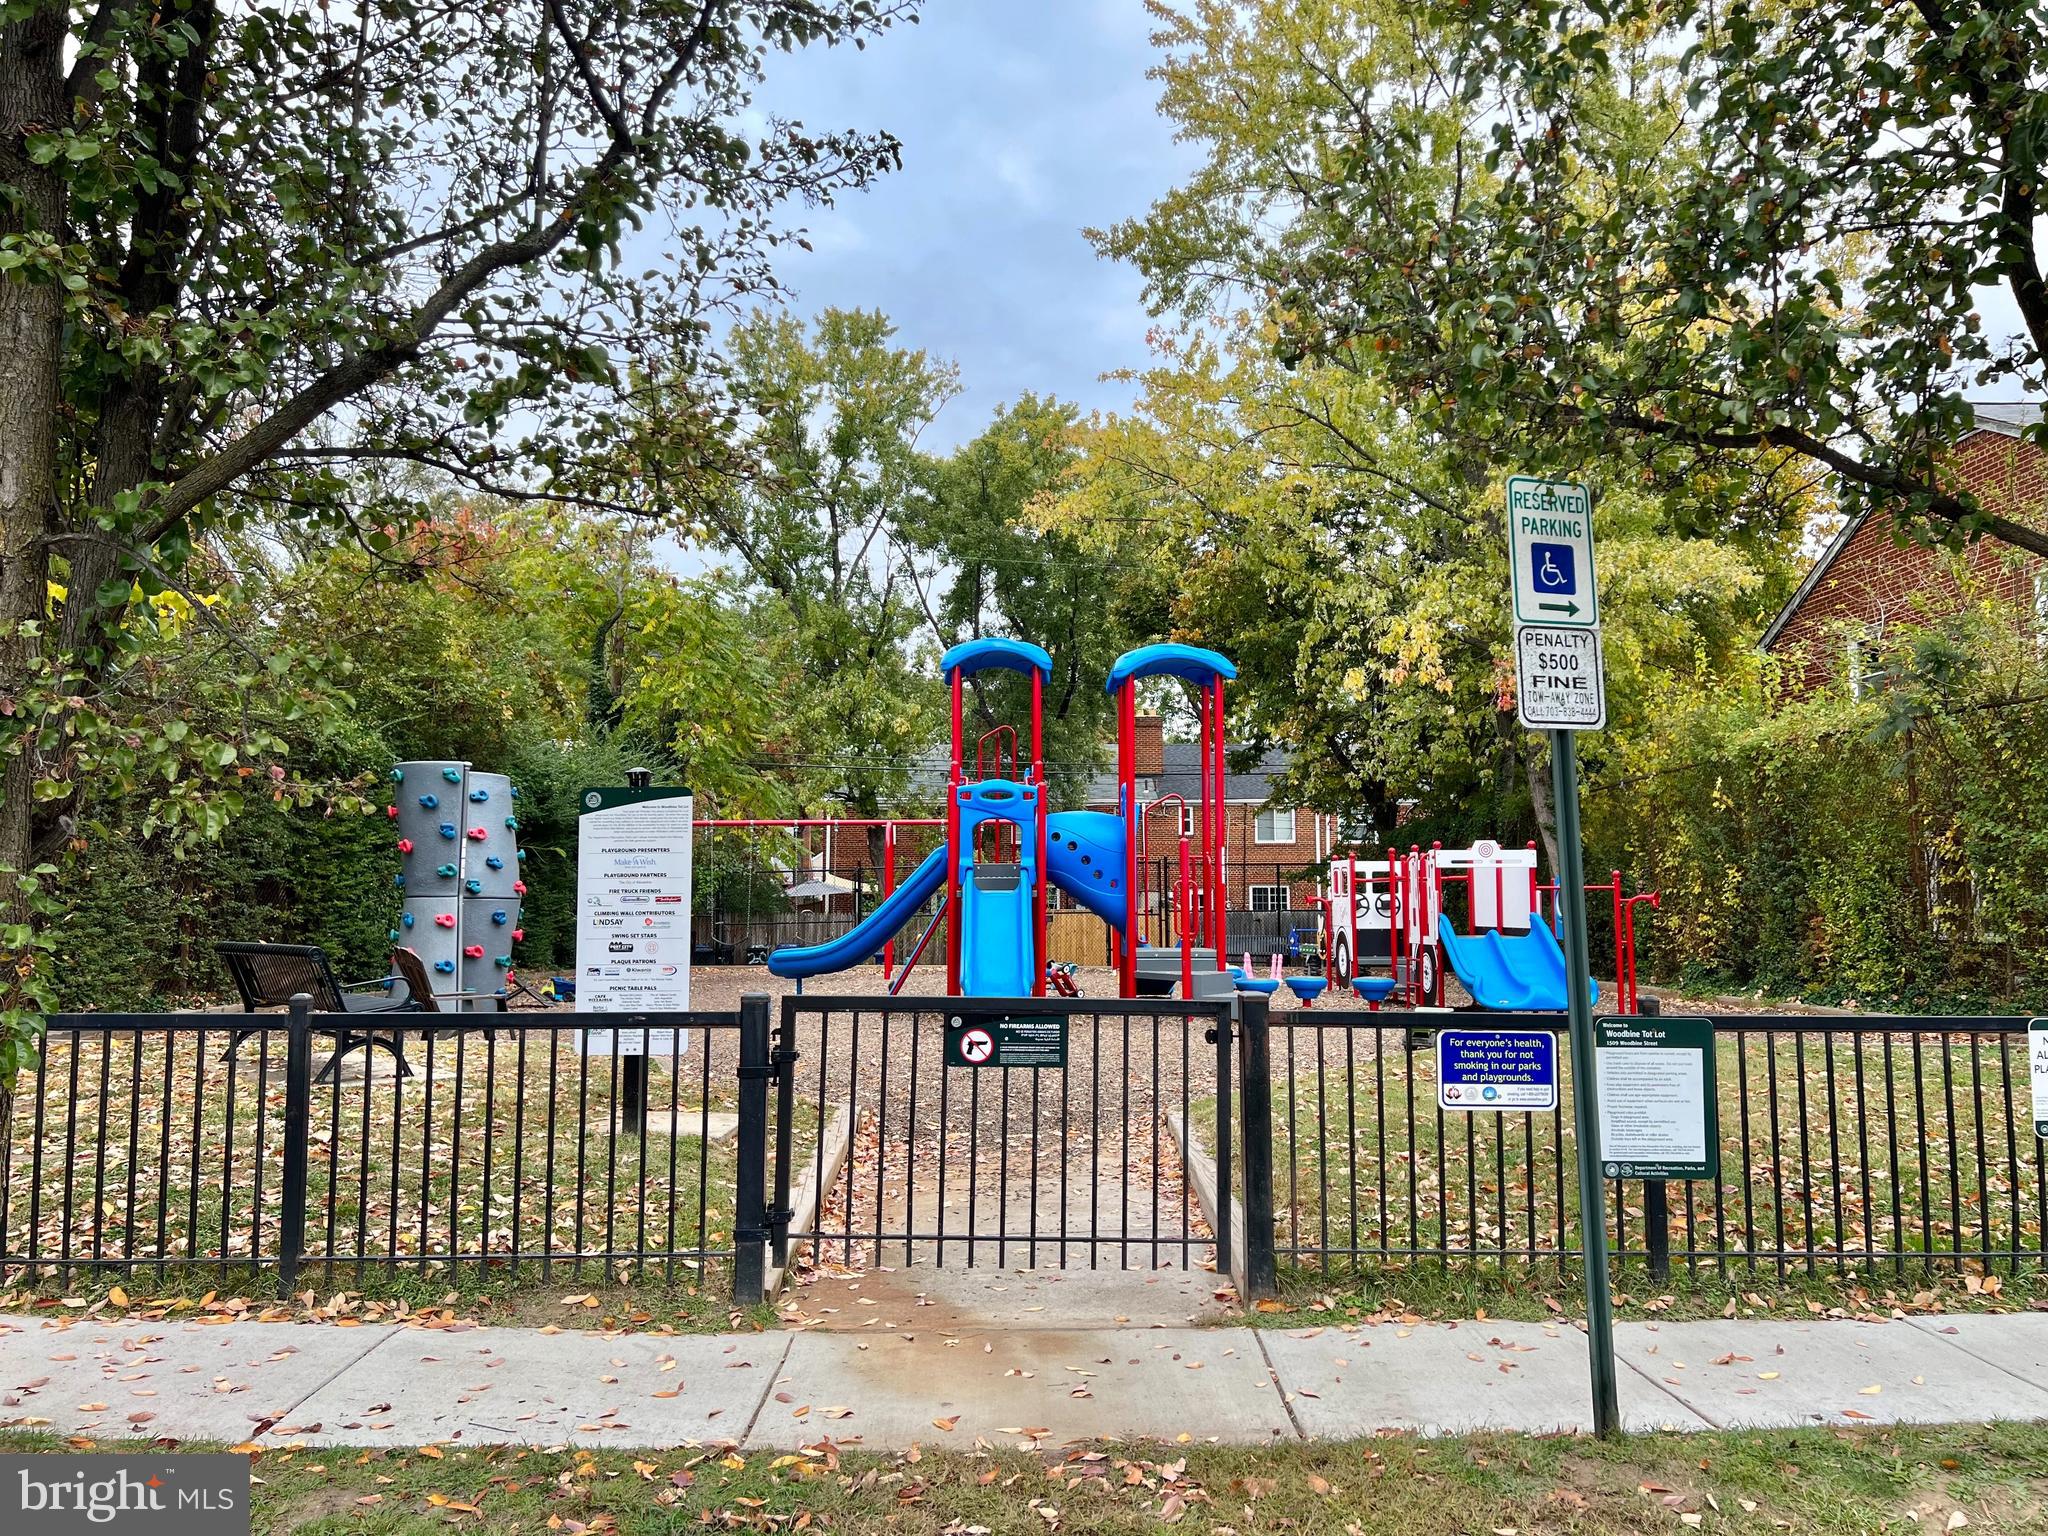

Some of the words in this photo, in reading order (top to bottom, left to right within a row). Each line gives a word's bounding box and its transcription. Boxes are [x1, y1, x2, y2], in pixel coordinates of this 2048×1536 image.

[1515, 491, 1584, 514] RESERVED
[1522, 517, 1581, 538] PARKING
[1526, 633, 1588, 648] PENALTY
[1539, 653, 1578, 670] $500
[1533, 675, 1587, 689] FINE
[1528, 691, 1569, 704] TOW-AWAY
[1575, 693, 1594, 704] ZONE
[1528, 706, 1544, 716] CALL
[1606, 1030, 1640, 1038] Woodbine
[1642, 1030, 1653, 1038] Tot
[1450, 1038, 1464, 1046] For
[1466, 1039, 1512, 1048] everyone's
[1514, 1039, 1544, 1049] health,
[1461, 1050, 1485, 1058] thank
[1487, 1052, 1502, 1060] you
[1505, 1050, 1517, 1059] for
[1519, 1051, 1534, 1059] not
[1454, 1062, 1488, 1071] smoking
[1491, 1062, 1499, 1070] in
[1518, 1062, 1541, 1072] parks
[1462, 1073, 1477, 1081] and
[1480, 1073, 1534, 1083] playgrounds.
